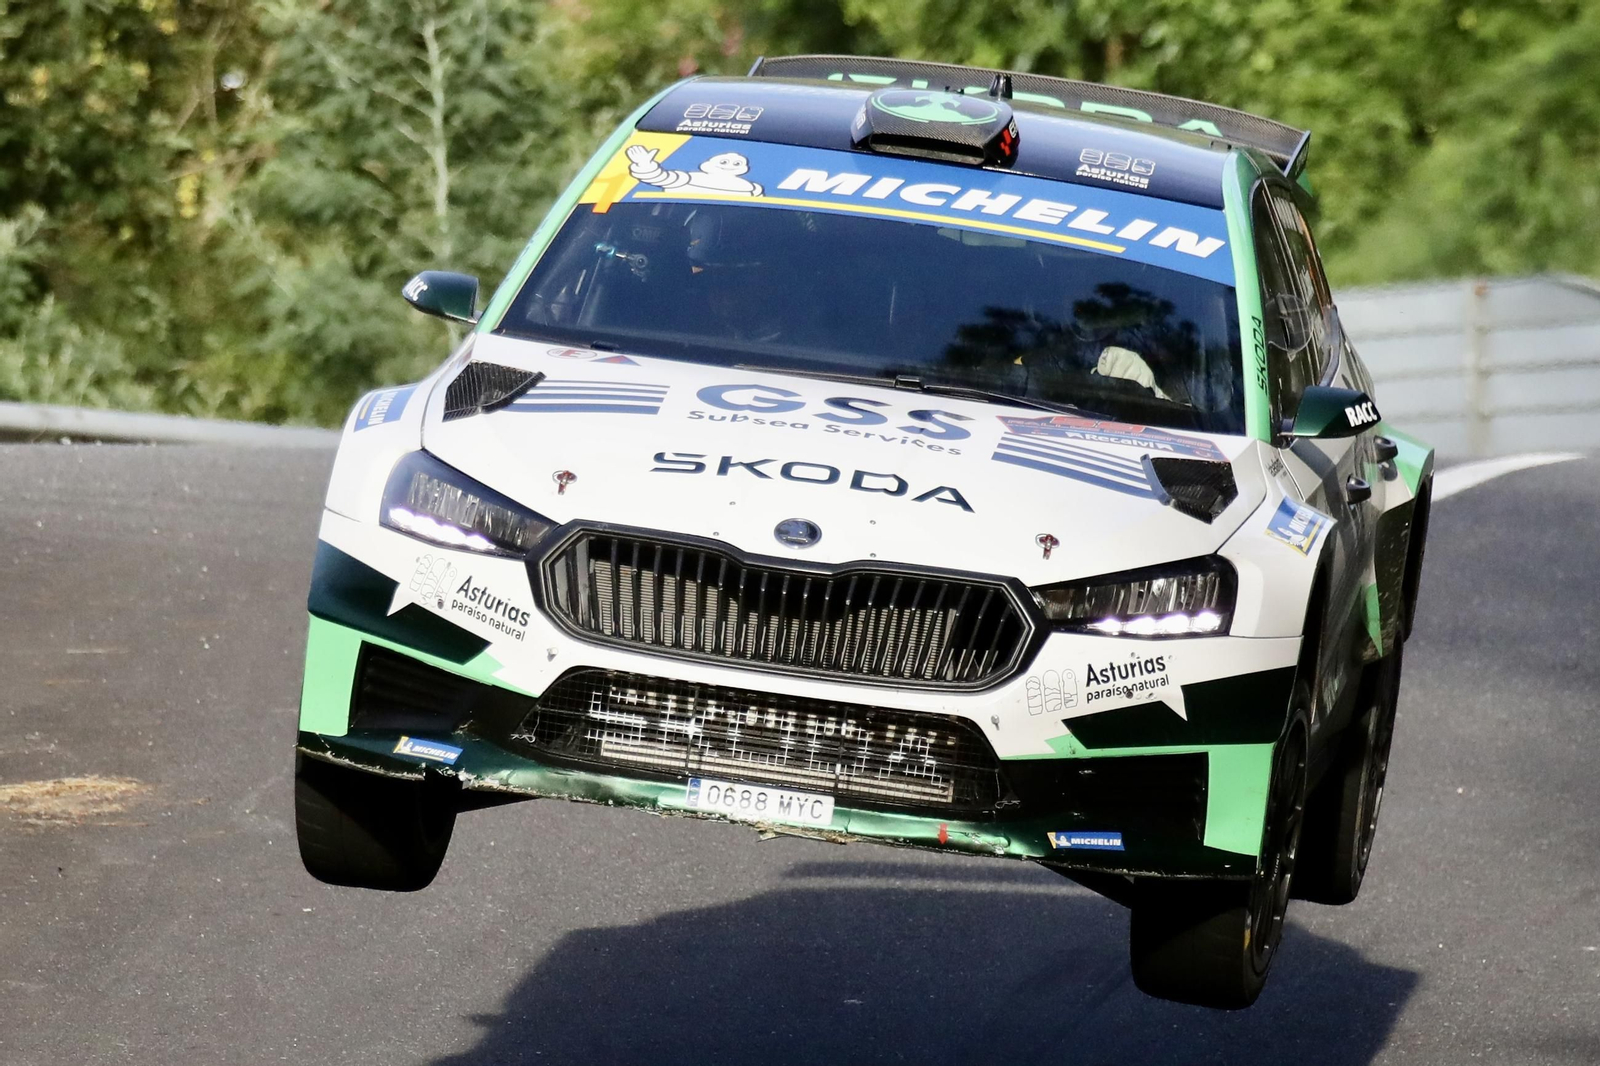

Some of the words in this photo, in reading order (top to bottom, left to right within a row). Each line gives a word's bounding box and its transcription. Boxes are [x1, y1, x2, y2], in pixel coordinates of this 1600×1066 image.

[678, 119, 753, 130] Asturias
[1077, 164, 1149, 184] Asturias
[776, 168, 1226, 258] MICHELIN
[1251, 315, 1268, 396] SKODA
[695, 384, 976, 440] GSS
[1345, 401, 1378, 427] RACC
[686, 410, 810, 430] Subsea
[822, 424, 962, 456] Services
[649, 452, 975, 514] SKODA
[456, 575, 531, 627] Asturias
[451, 598, 487, 623] paraíso
[489, 617, 526, 642] natural
[1085, 655, 1166, 687] Asturias
[1086, 684, 1131, 704] paraíso
[1131, 674, 1170, 693] natural
[411, 745, 459, 760] MICHELIN
[707, 785, 768, 811] 0688
[778, 794, 823, 819] MYC
[1071, 838, 1121, 846] MICHELIN
